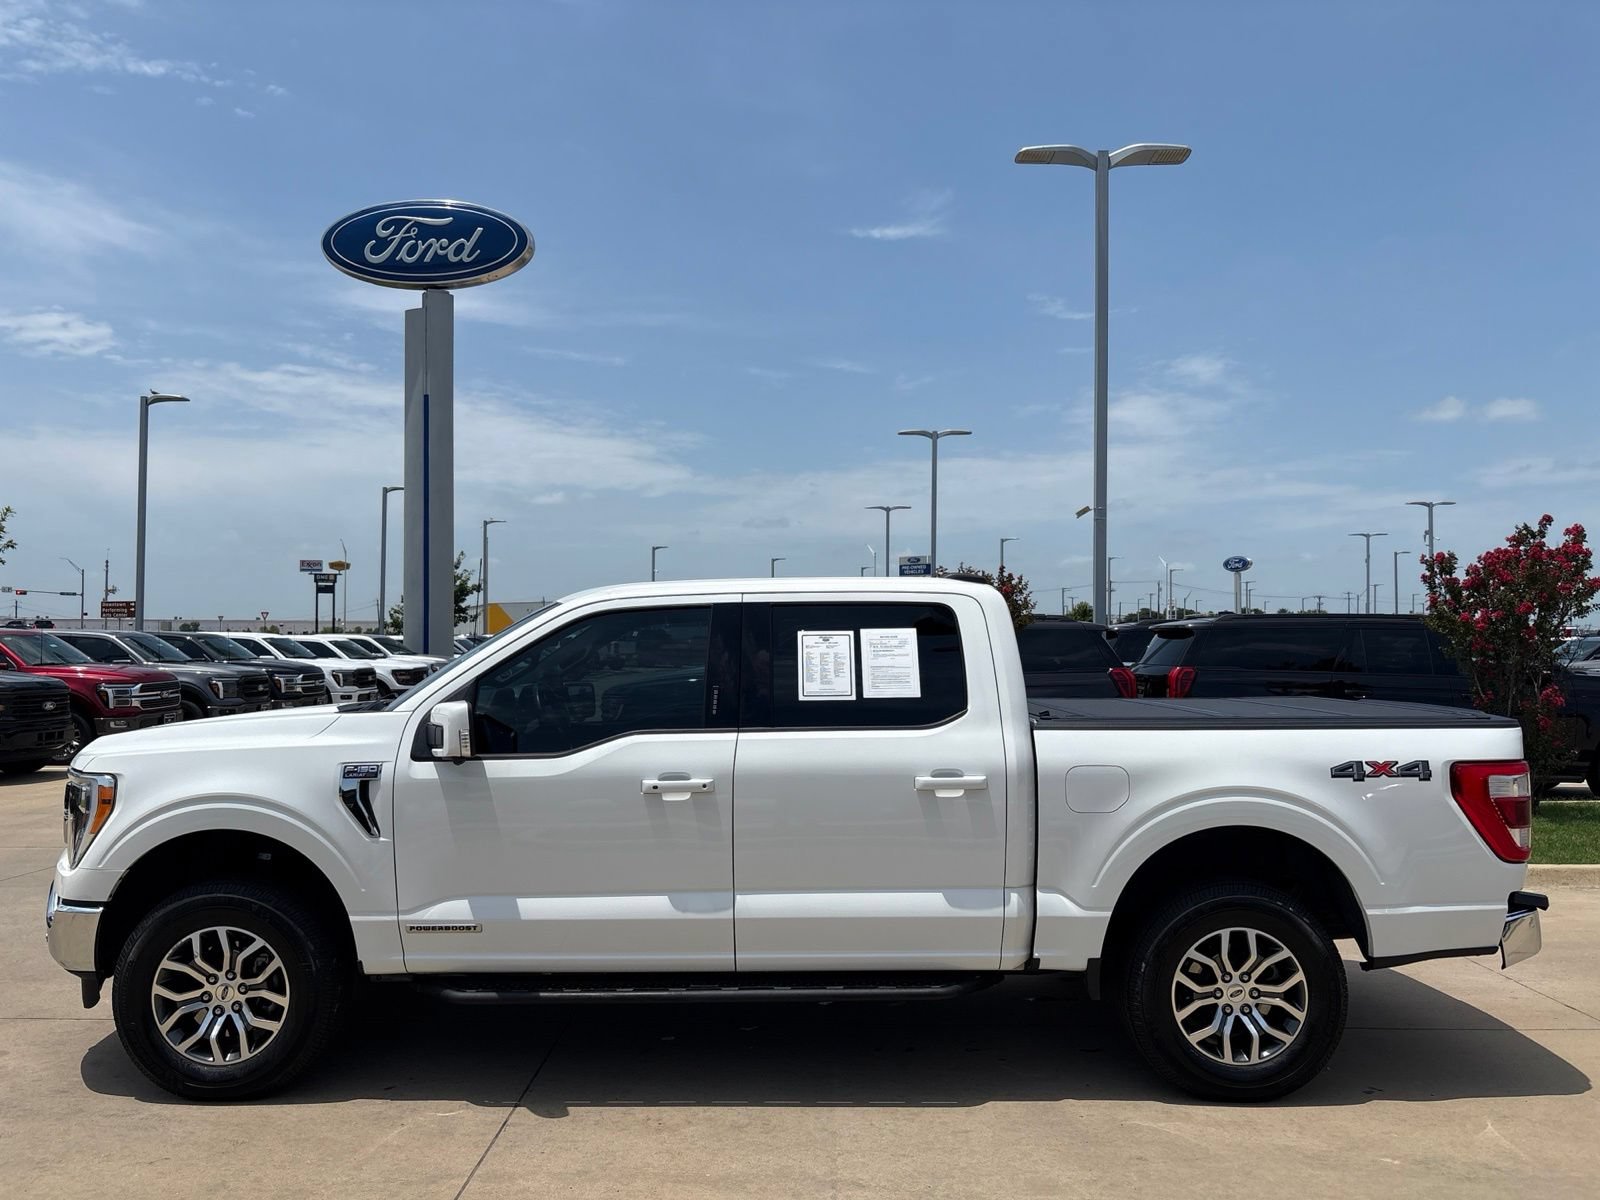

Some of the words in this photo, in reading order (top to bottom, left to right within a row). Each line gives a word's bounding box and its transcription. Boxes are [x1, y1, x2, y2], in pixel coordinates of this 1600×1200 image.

[364, 215, 484, 264] Ford
[301, 560, 322, 569] Exxon
[345, 765, 378, 773] F-150
